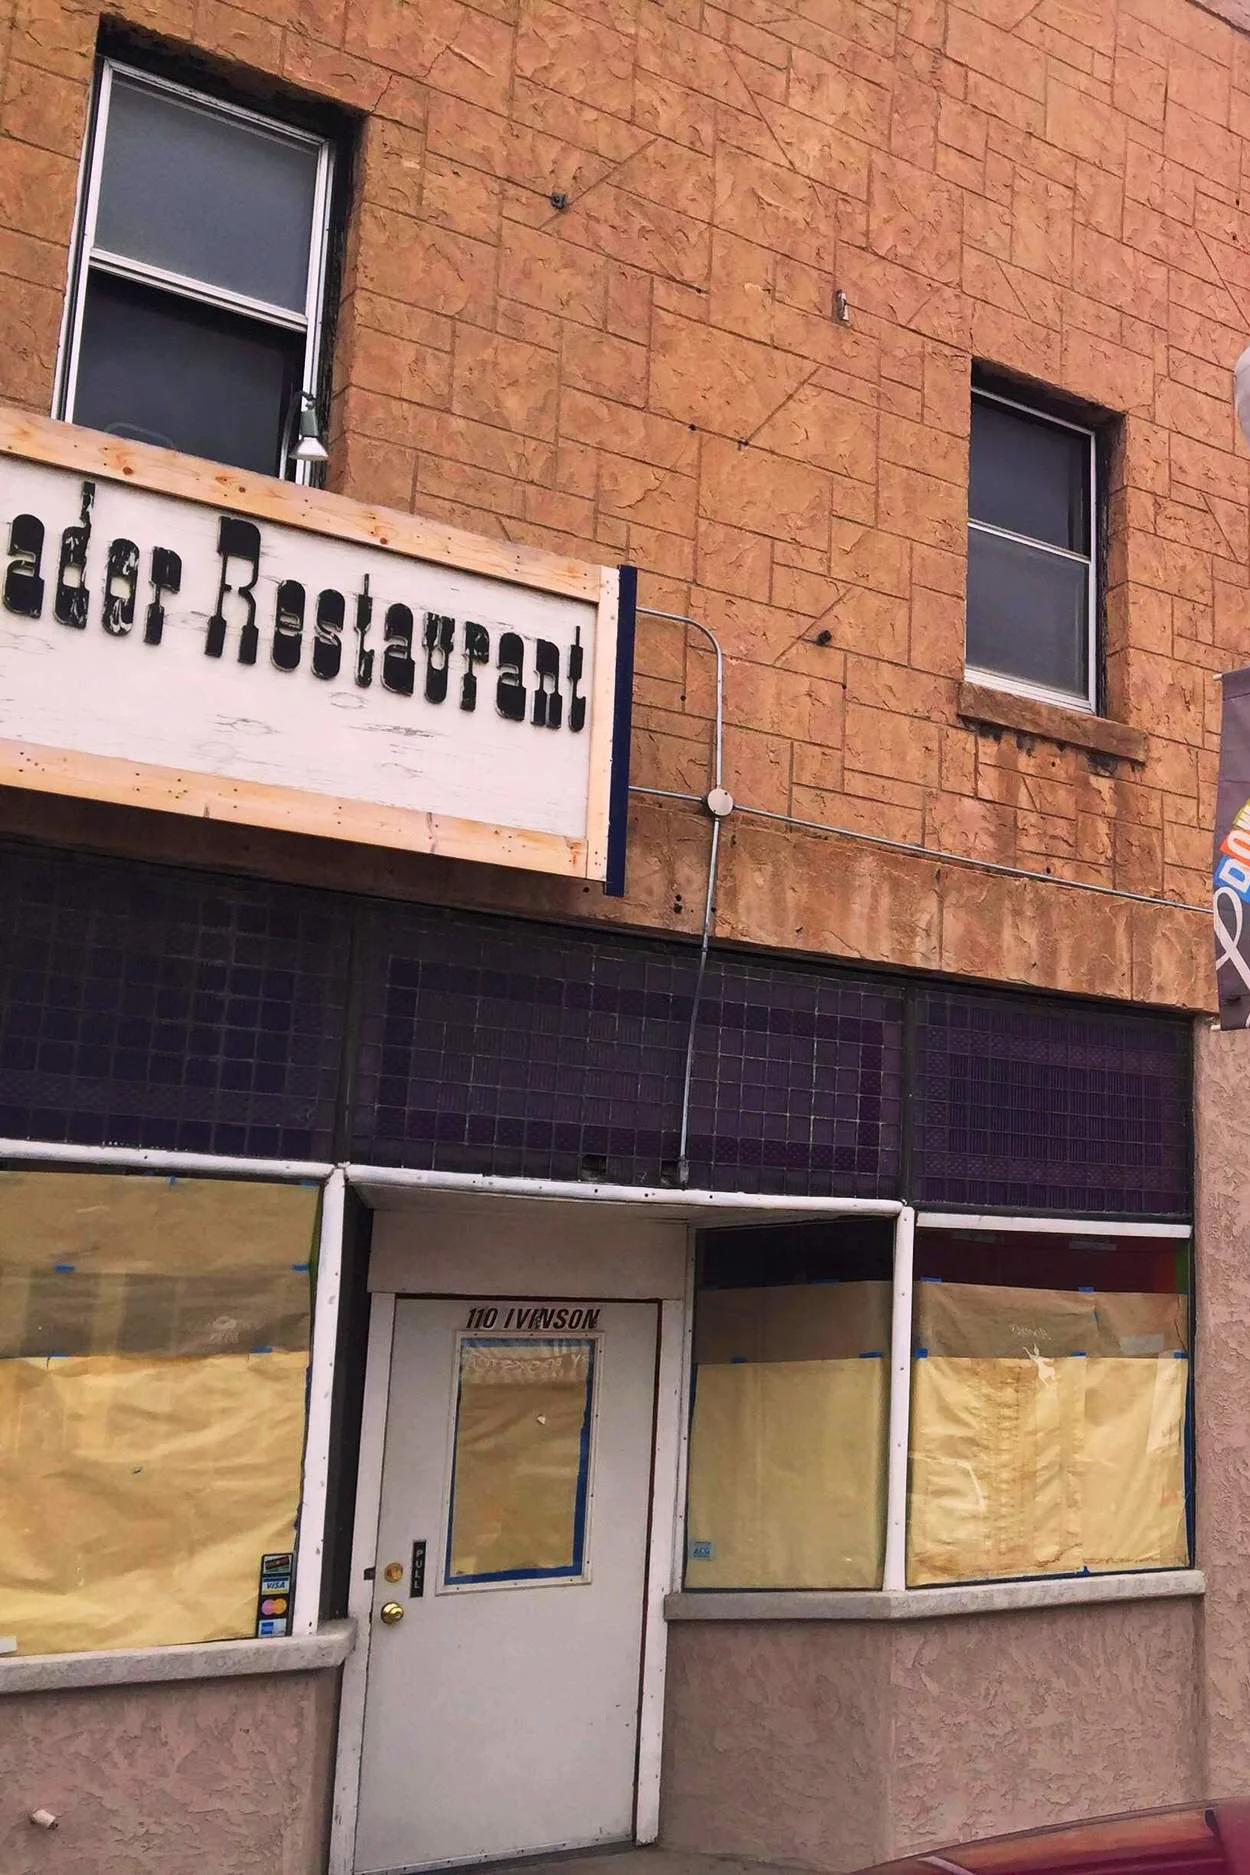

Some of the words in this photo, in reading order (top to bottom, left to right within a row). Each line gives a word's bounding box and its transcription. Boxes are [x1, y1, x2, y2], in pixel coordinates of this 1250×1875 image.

[2, 479, 183, 646] ador
[204, 515, 588, 733] Restaurant
[466, 1307, 499, 1330] 110
[503, 1307, 601, 1330] IVINSON
[414, 1548, 424, 1589] PULL
[266, 1581, 286, 1590] VISA
